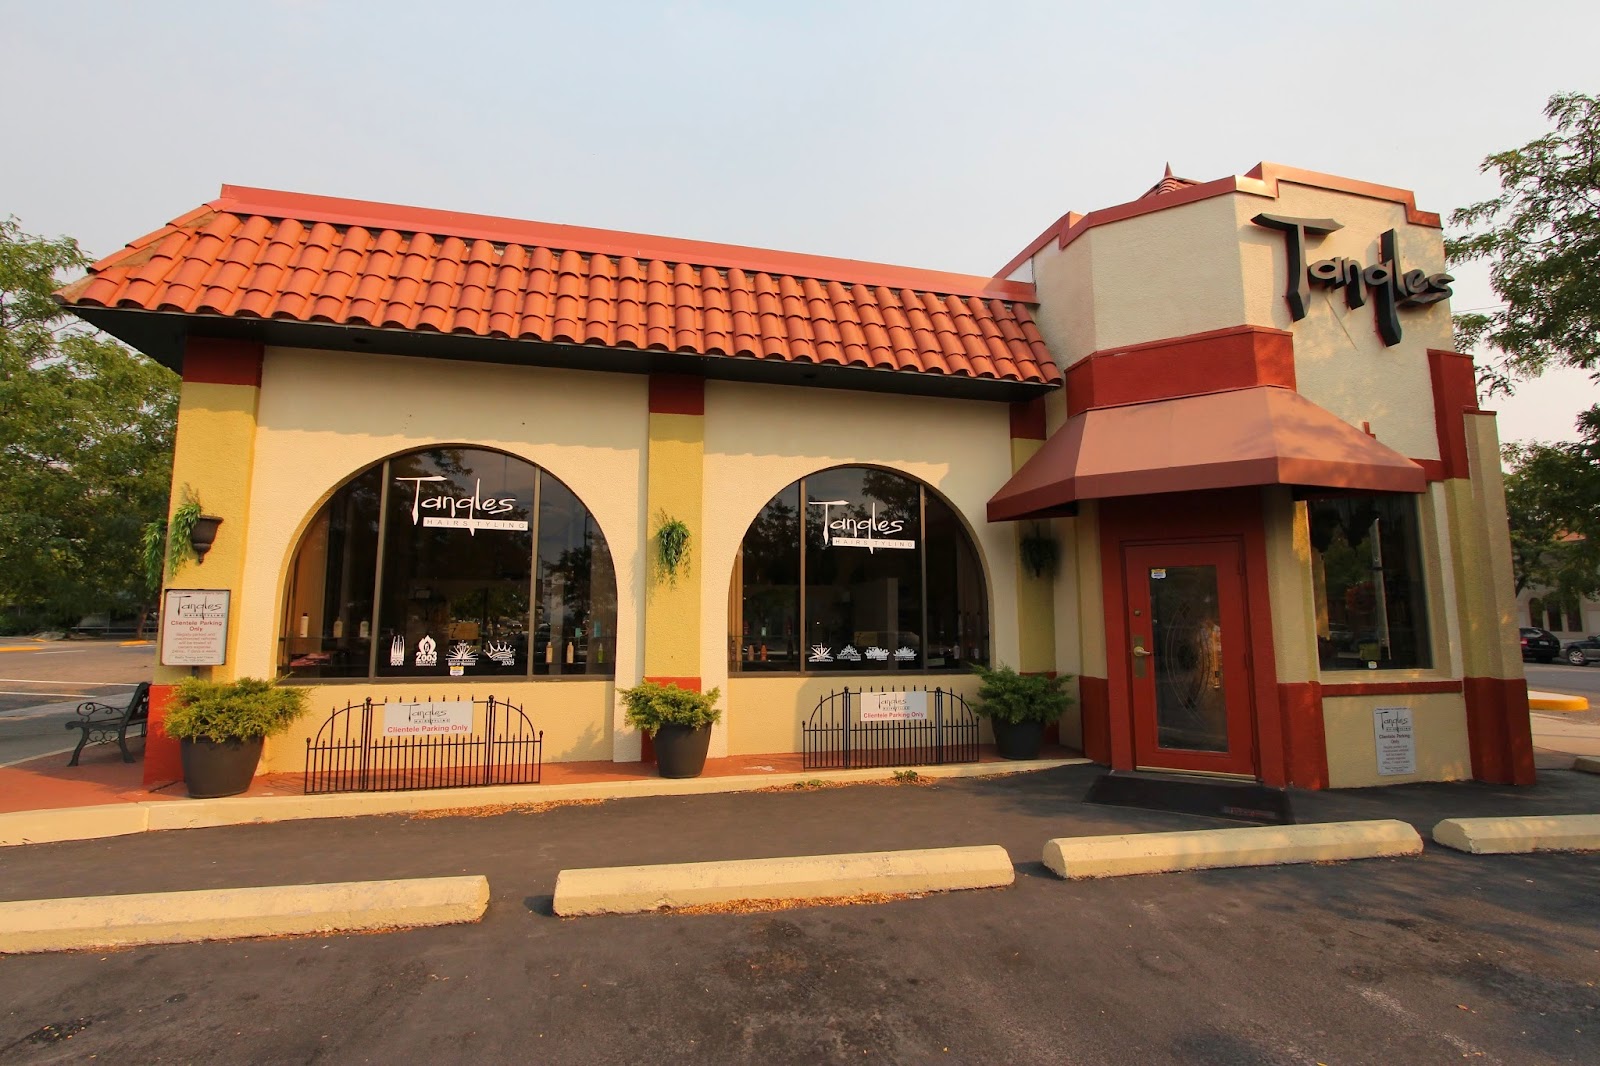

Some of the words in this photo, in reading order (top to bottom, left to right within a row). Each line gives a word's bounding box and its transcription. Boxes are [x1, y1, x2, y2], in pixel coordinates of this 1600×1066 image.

[1250, 213, 1455, 347] Tangles
[395, 476, 516, 536] Tangles
[808, 500, 905, 554] Tangles
[170, 596, 222, 620] Tangles
[415, 651, 438, 661] 2003
[401, 703, 447, 725] Tangles
[1376, 711, 1408, 733] Tangles
[421, 725, 450, 733] Parking
[451, 724, 468, 732] Only
